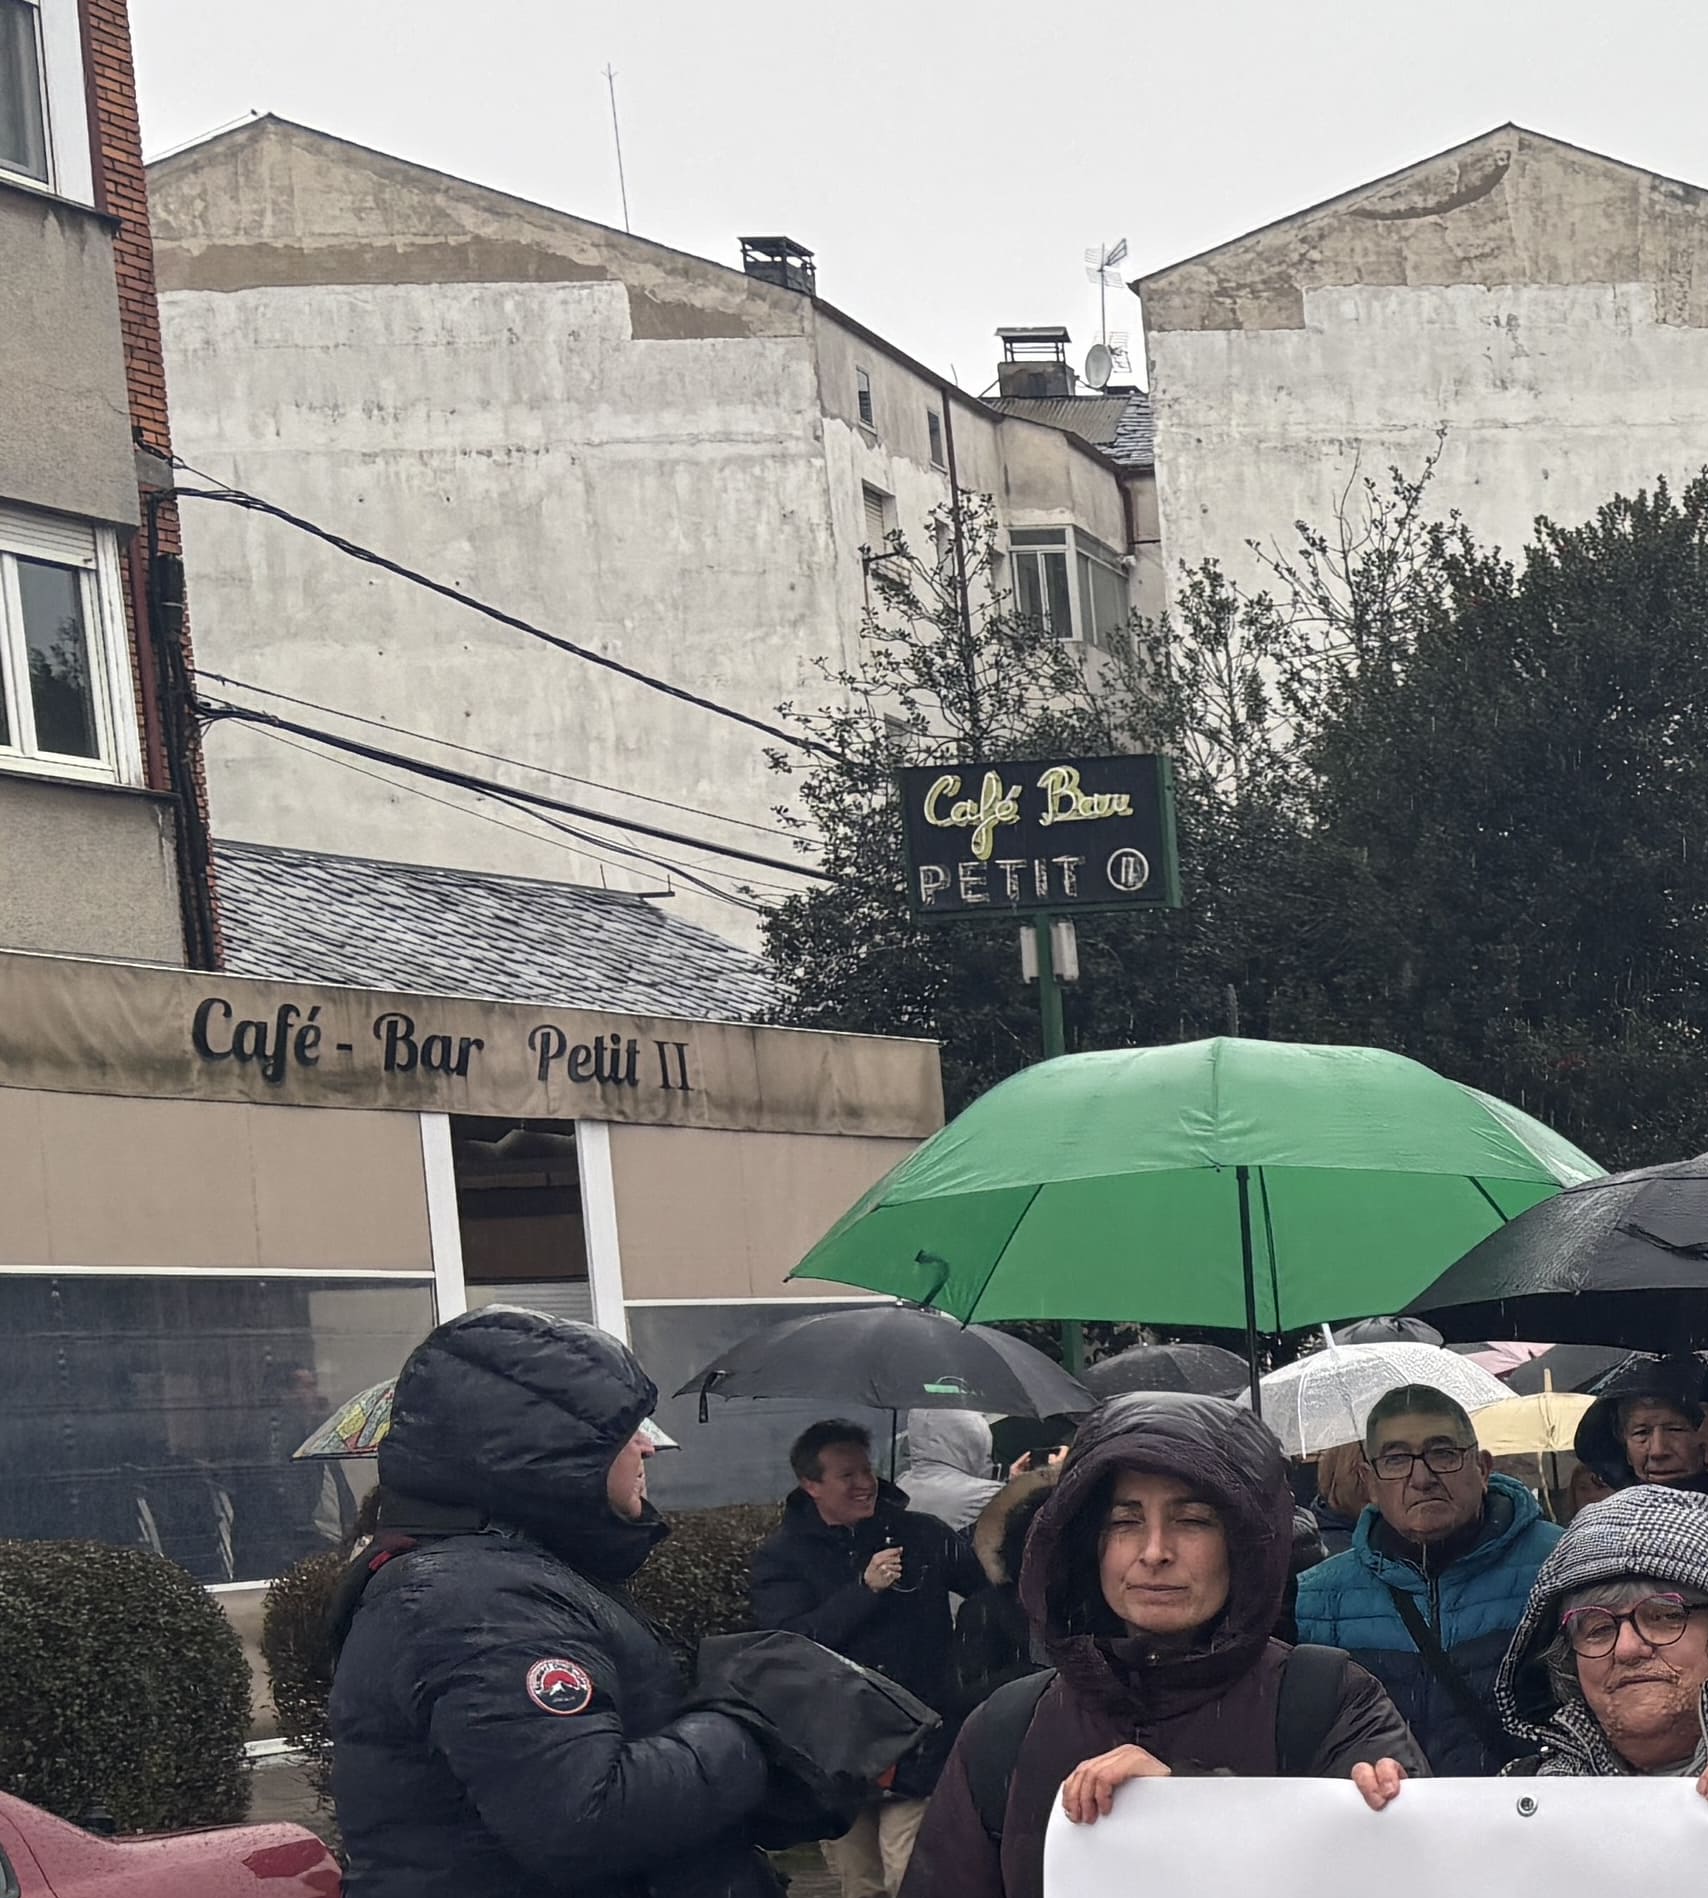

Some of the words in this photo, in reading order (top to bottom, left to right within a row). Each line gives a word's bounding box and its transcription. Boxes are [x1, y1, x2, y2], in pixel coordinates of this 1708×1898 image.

[923, 769, 1023, 861] Café
[1036, 764, 1135, 827] Bar
[918, 854, 1087, 905] PETIT
[191, 997, 322, 1085] Café
[372, 1011, 485, 1078] Bar
[527, 1023, 641, 1088] Petit
[652, 1039, 695, 1092] II
